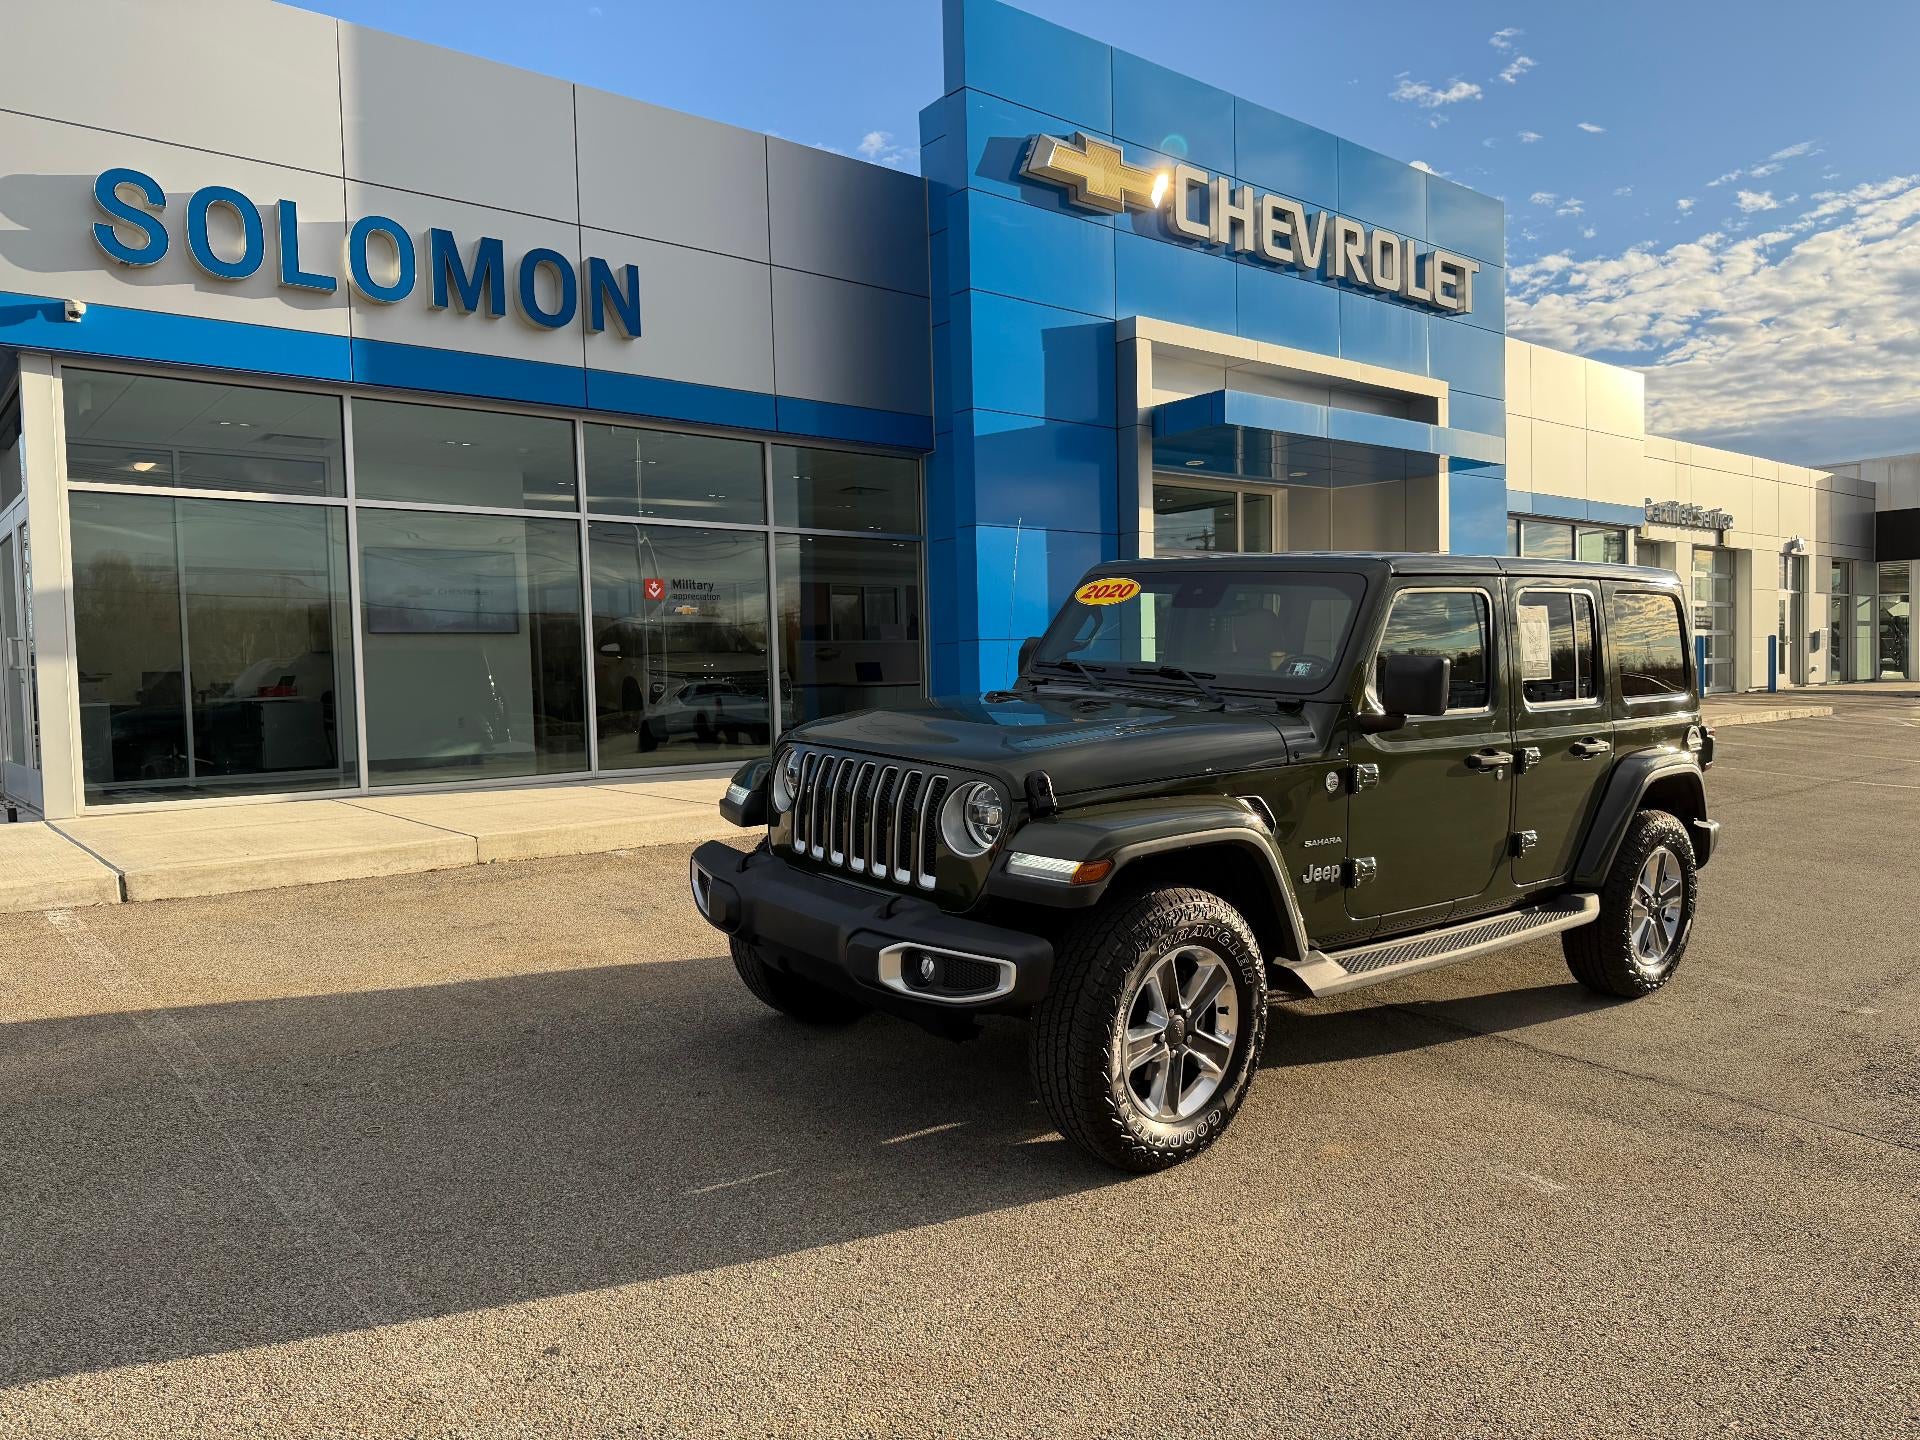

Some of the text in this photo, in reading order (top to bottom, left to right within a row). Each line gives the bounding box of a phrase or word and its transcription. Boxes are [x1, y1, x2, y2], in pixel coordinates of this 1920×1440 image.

[1171, 163, 1481, 315] CHEVROLET
[91, 166, 642, 341] SOLOMON
[1644, 497, 1692, 525] Certified
[672, 578, 714, 592] Military
[672, 592, 721, 602] appreciation
[1079, 583, 1136, 600] 2020
[1303, 836, 1343, 848] SAHARA
[1302, 863, 1341, 884] Jeep
[1157, 923, 1256, 985] WRANGLER
[1115, 1087, 1222, 1148] GOODYEAR
